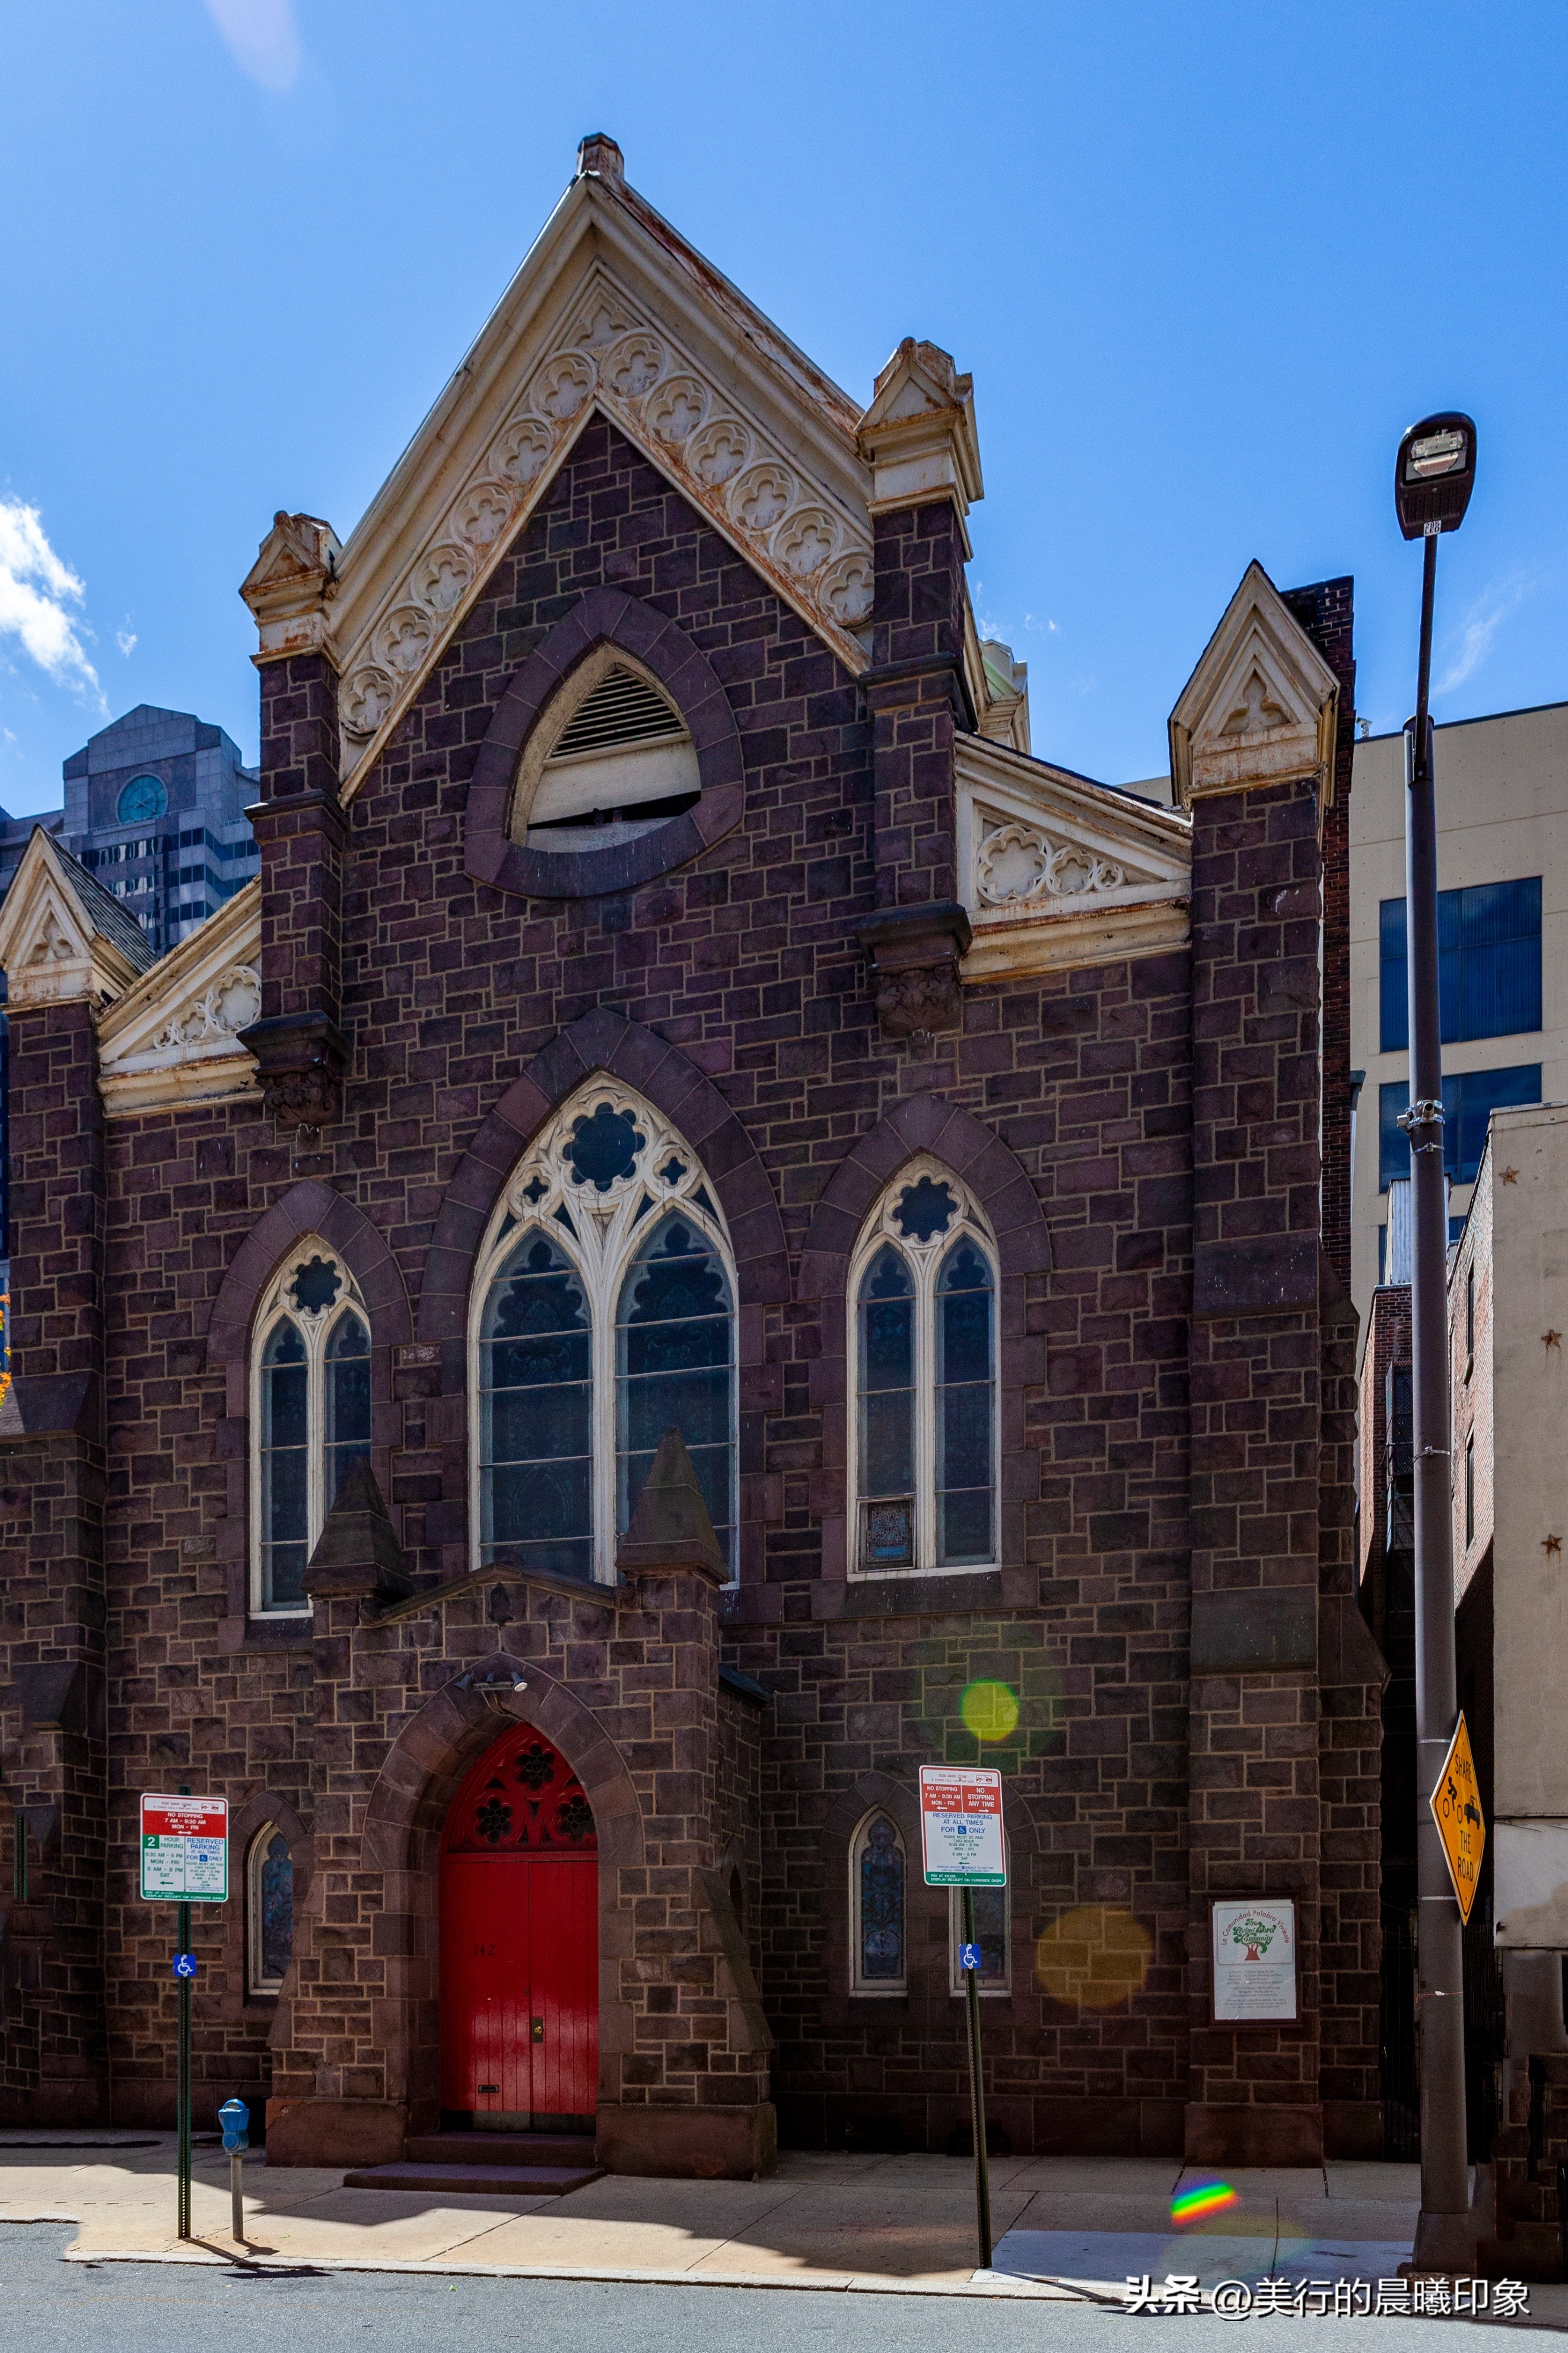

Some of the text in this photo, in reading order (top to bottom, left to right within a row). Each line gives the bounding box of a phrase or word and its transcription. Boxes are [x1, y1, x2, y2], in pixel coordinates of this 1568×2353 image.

[1455, 1753, 1472, 1784] SHARE
[148, 1837, 155, 1846] 2
[1460, 1829, 1471, 1855] THE
[1457, 1856, 1474, 1882] ROAD
[1223, 1910, 1251, 1936] Comunidad
[1253, 1910, 1276, 1922] Palabra
[1277, 1920, 1290, 1944] Viviente
[1233, 1923, 1277, 1936] Living Word
[1241, 1933, 1273, 1945] Community
[475, 1944, 495, 1957] 142
